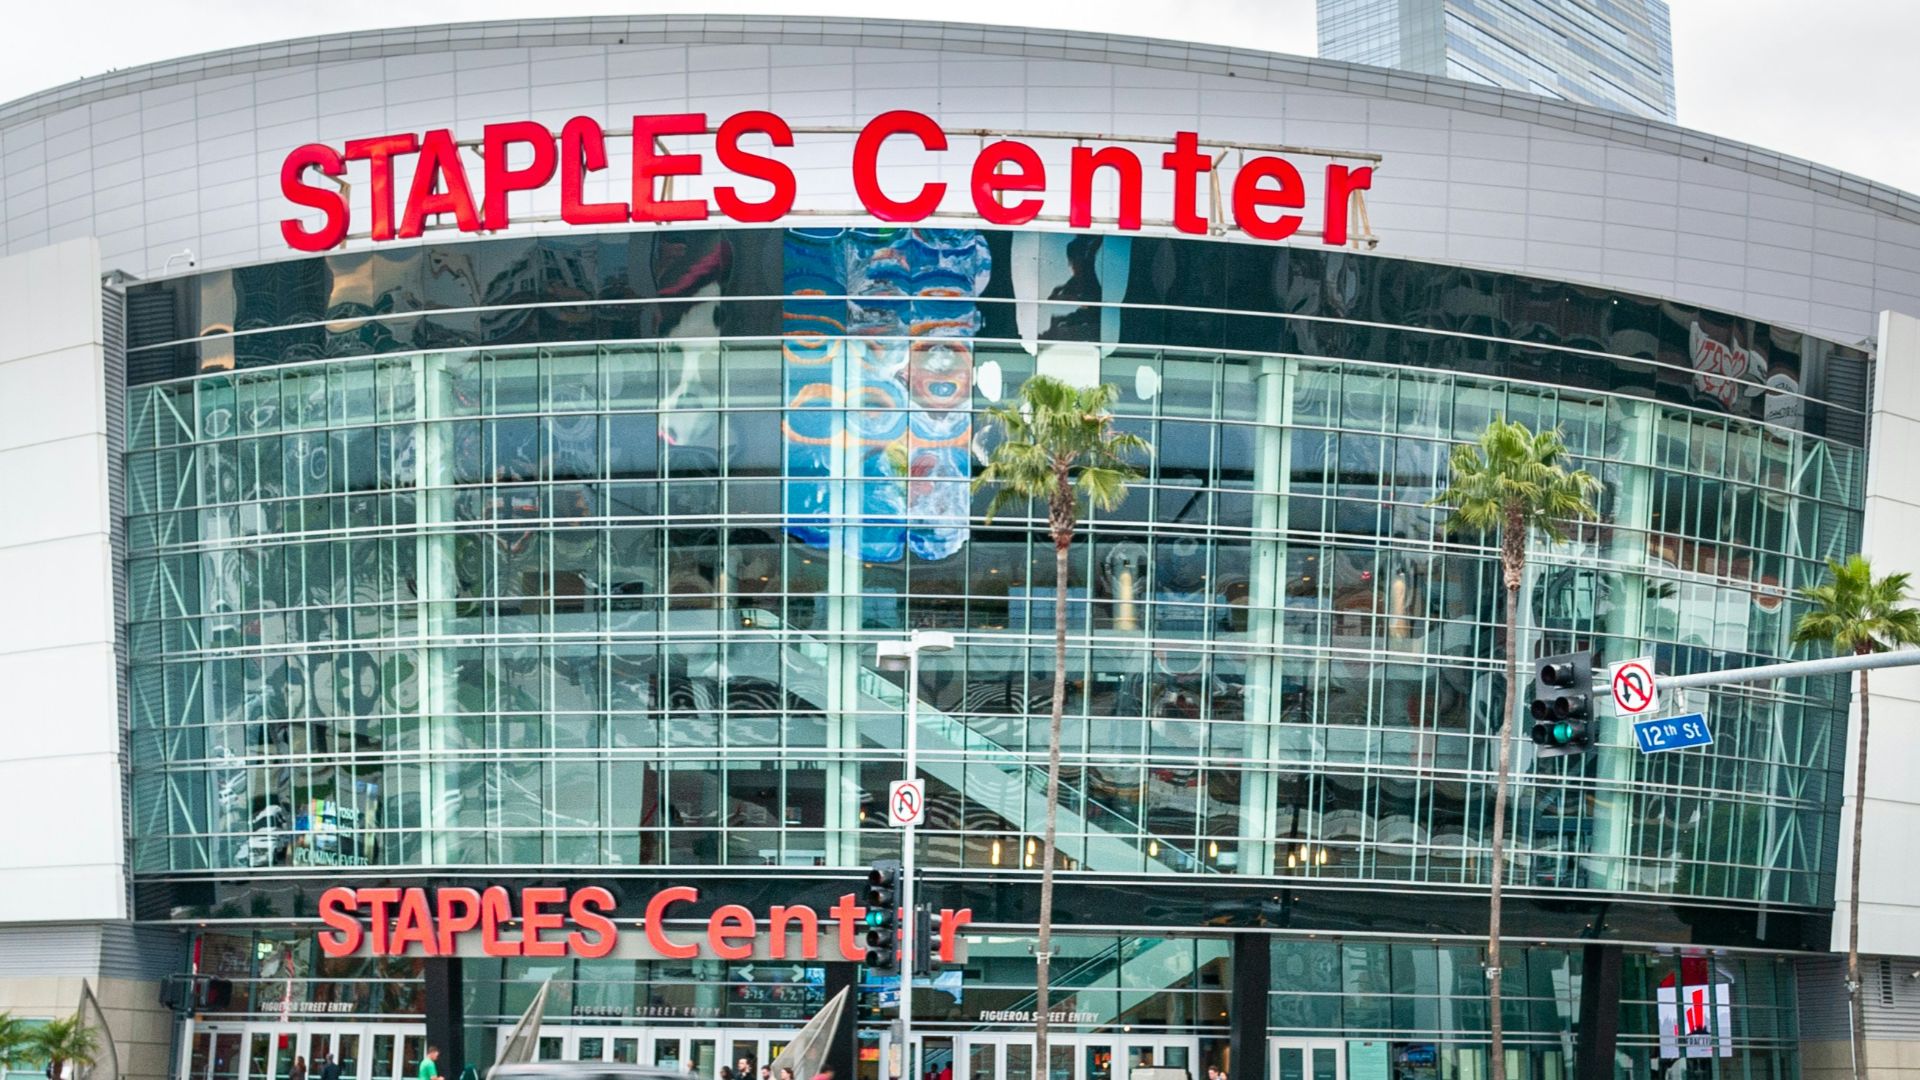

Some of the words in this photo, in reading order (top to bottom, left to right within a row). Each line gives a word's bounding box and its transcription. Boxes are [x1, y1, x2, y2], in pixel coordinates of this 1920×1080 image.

[280, 110, 797, 252] STAPLES
[852, 110, 1373, 246] Center
[1642, 724, 1678, 746] 12th
[1682, 721, 1702, 739] St
[318, 885, 618, 958] STAPLES
[644, 886, 972, 962] Centr
[300, 1002, 326, 1012] STREET
[327, 1002, 353, 1012] ENTRY
[573, 1006, 629, 1015] FIGUEROA
[635, 1006, 677, 1016] STREET
[684, 1006, 720, 1016] ENTRY
[980, 1010, 1030, 1021] FIGUEROA
[1031, 1011, 1067, 1022] SEET
[1068, 1012, 1099, 1022] ENTRY
